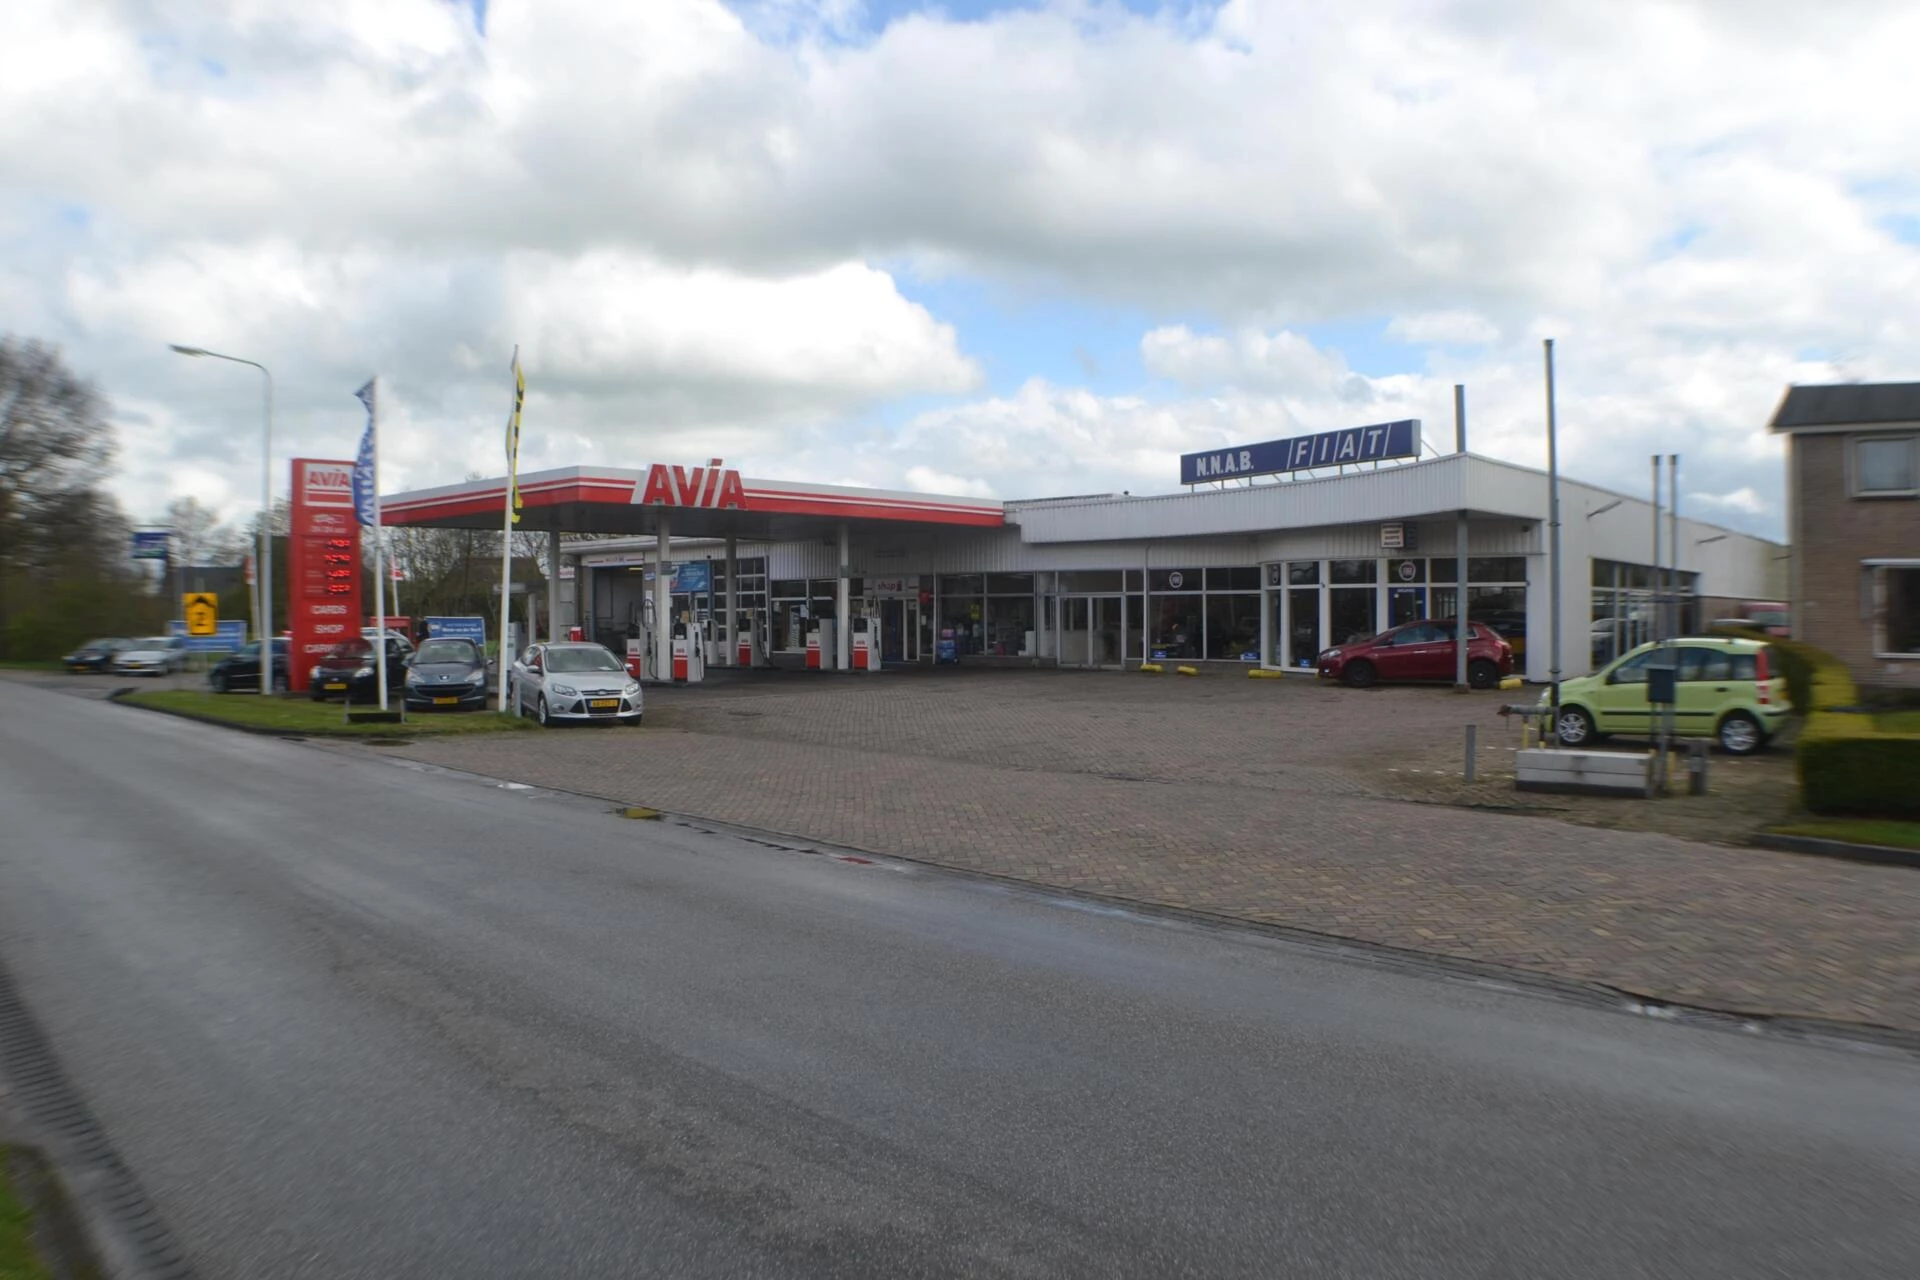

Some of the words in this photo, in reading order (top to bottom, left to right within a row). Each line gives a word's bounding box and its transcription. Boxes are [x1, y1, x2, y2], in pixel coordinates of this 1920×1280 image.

[1196, 450, 1254, 476] N.N.A.B.
[1294, 429, 1382, 465] FIAT
[643, 458, 748, 510] AVIA
[311, 604, 347, 615] CARDS
[314, 624, 344, 634] SHOP
